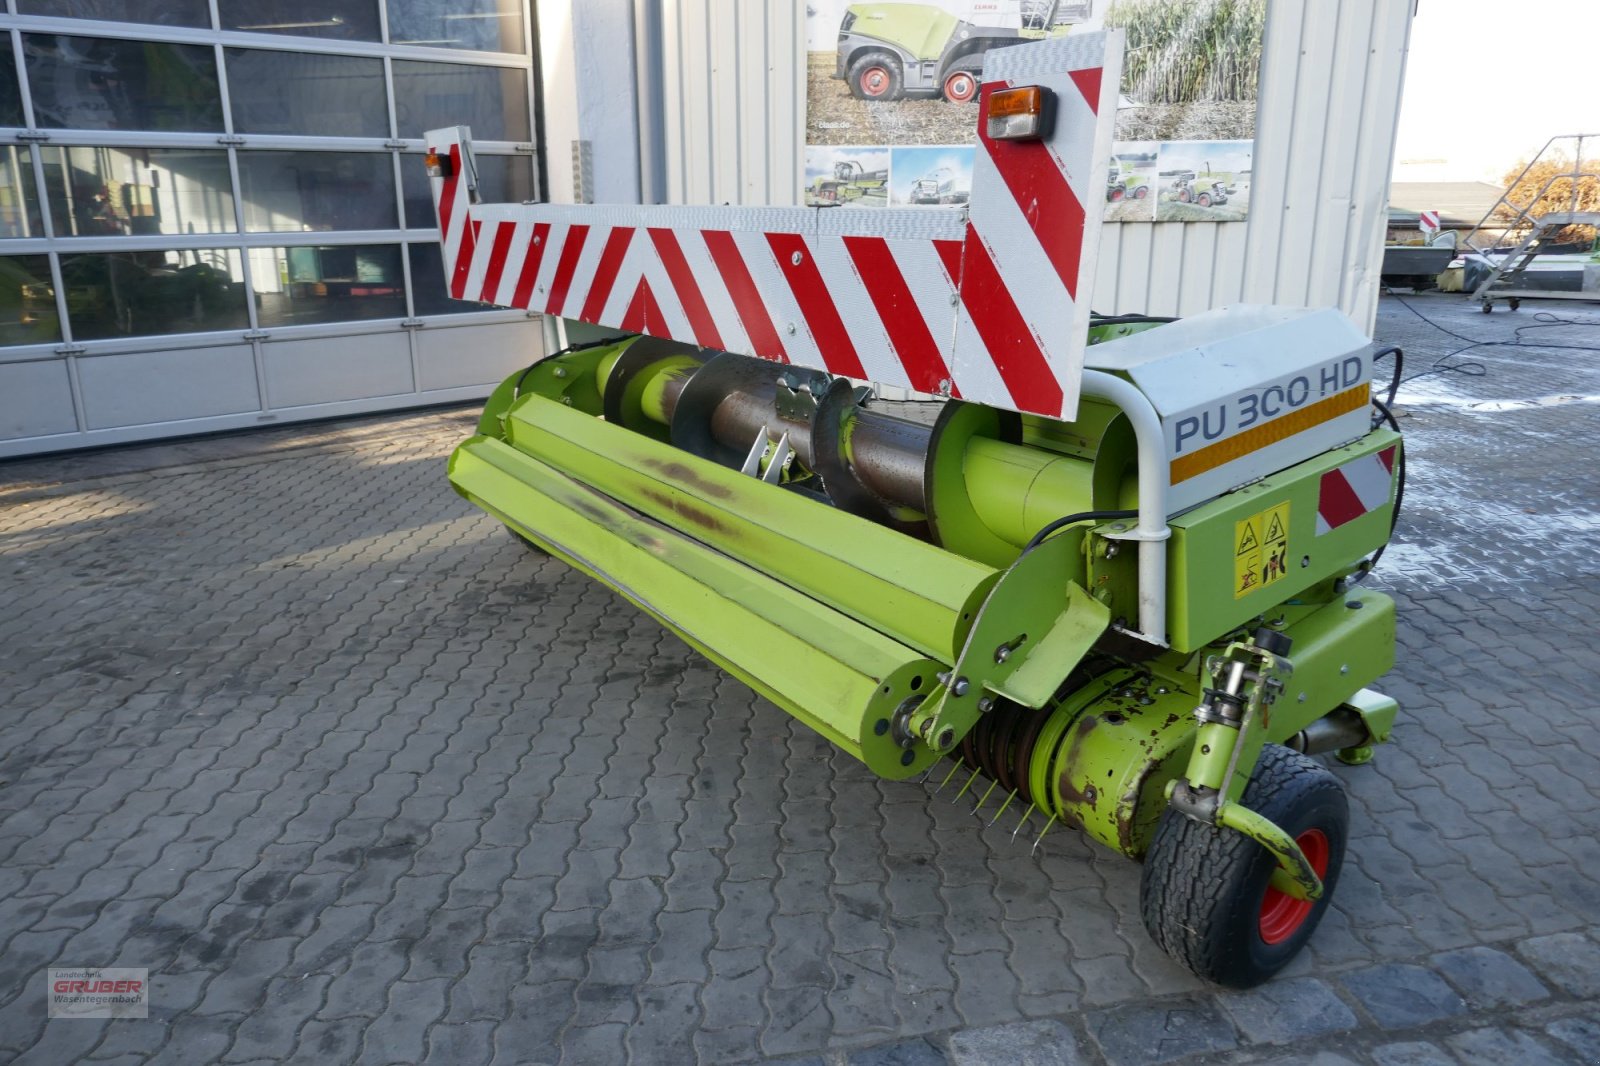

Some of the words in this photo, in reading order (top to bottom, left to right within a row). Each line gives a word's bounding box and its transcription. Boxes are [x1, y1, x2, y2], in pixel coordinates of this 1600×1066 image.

[1174, 404, 1226, 453] PU
[1238, 376, 1309, 429] 300
[1319, 356, 1362, 397] HD
